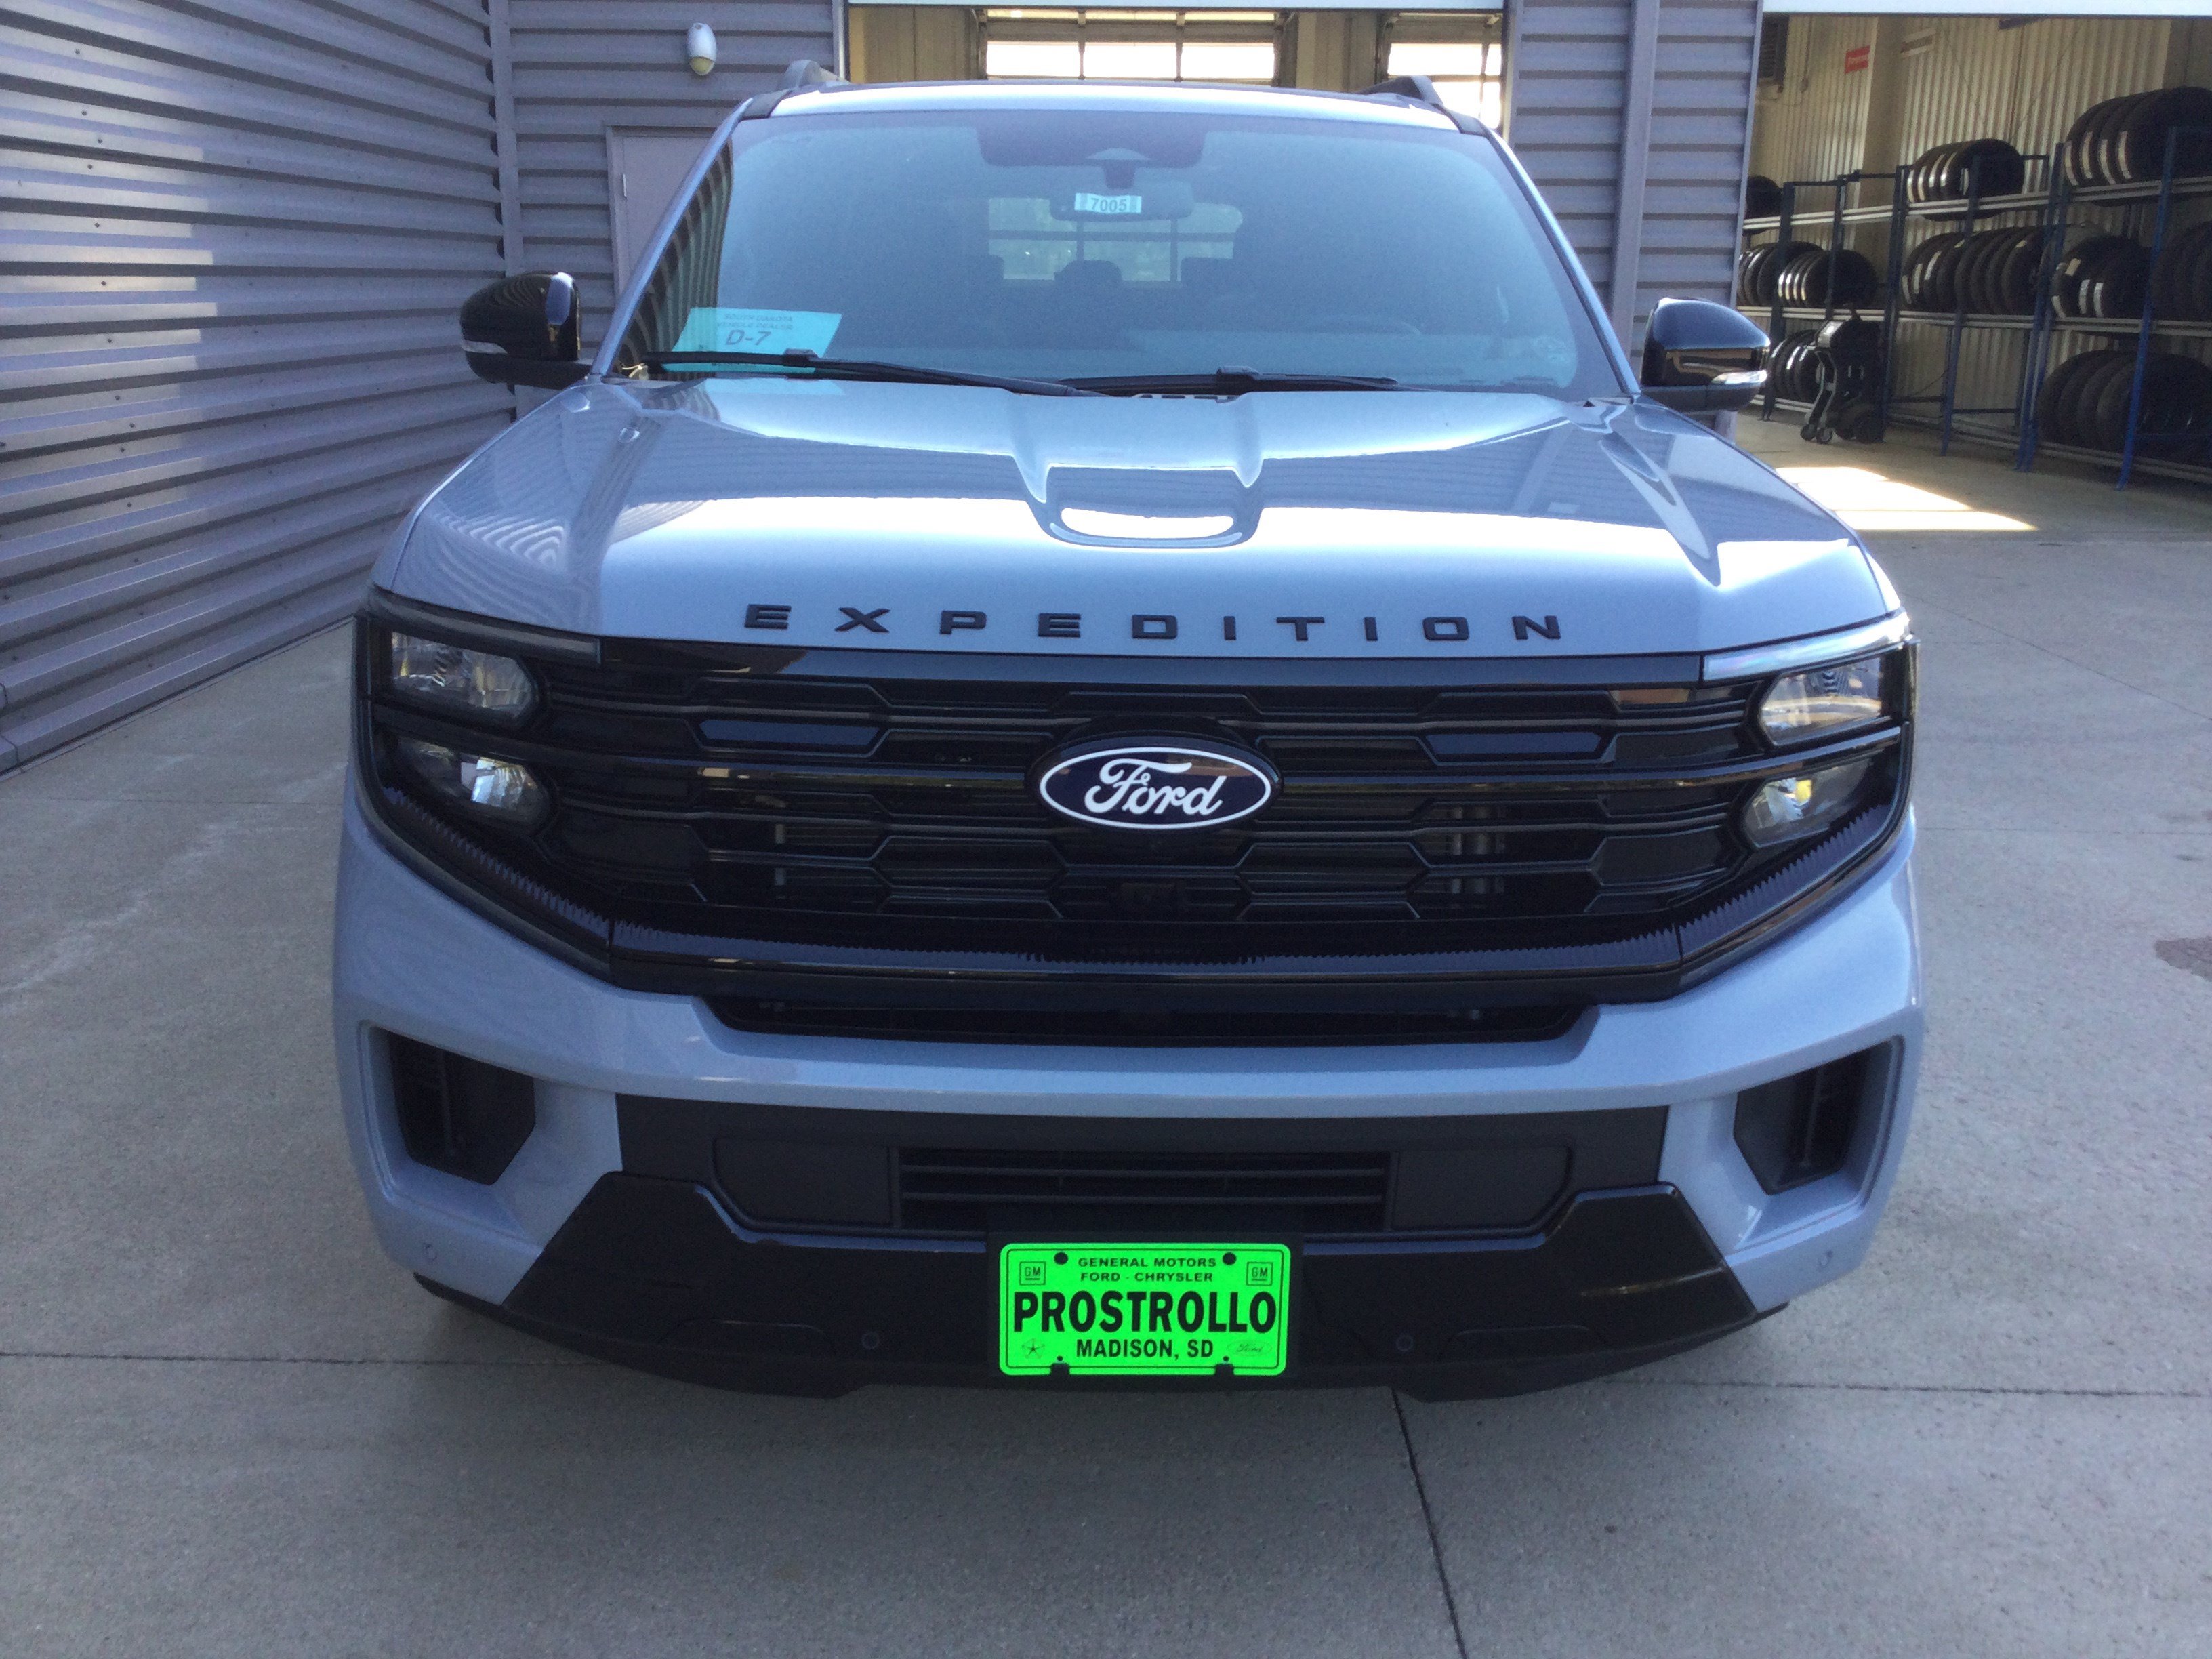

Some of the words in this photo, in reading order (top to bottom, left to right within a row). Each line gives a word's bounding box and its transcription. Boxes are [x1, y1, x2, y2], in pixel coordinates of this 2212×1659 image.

[1091, 197, 1127, 212] 7005
[725, 329, 771, 346] D-7
[744, 604, 1561, 641] EXPEDITION
[1085, 758, 1227, 815] Ford
[1078, 1257, 1148, 1267] GENERAL
[1153, 1258, 1216, 1267] MOTORS
[1025, 1266, 1040, 1277] GM
[1080, 1272, 1120, 1282] FORD
[1134, 1272, 1213, 1282] CHRYSLER
[1252, 1267, 1268, 1277] GM
[1014, 1290, 1277, 1334] PROSTROLLO
[1076, 1339, 1179, 1360] MADISON,
[1187, 1339, 1214, 1357] SD
